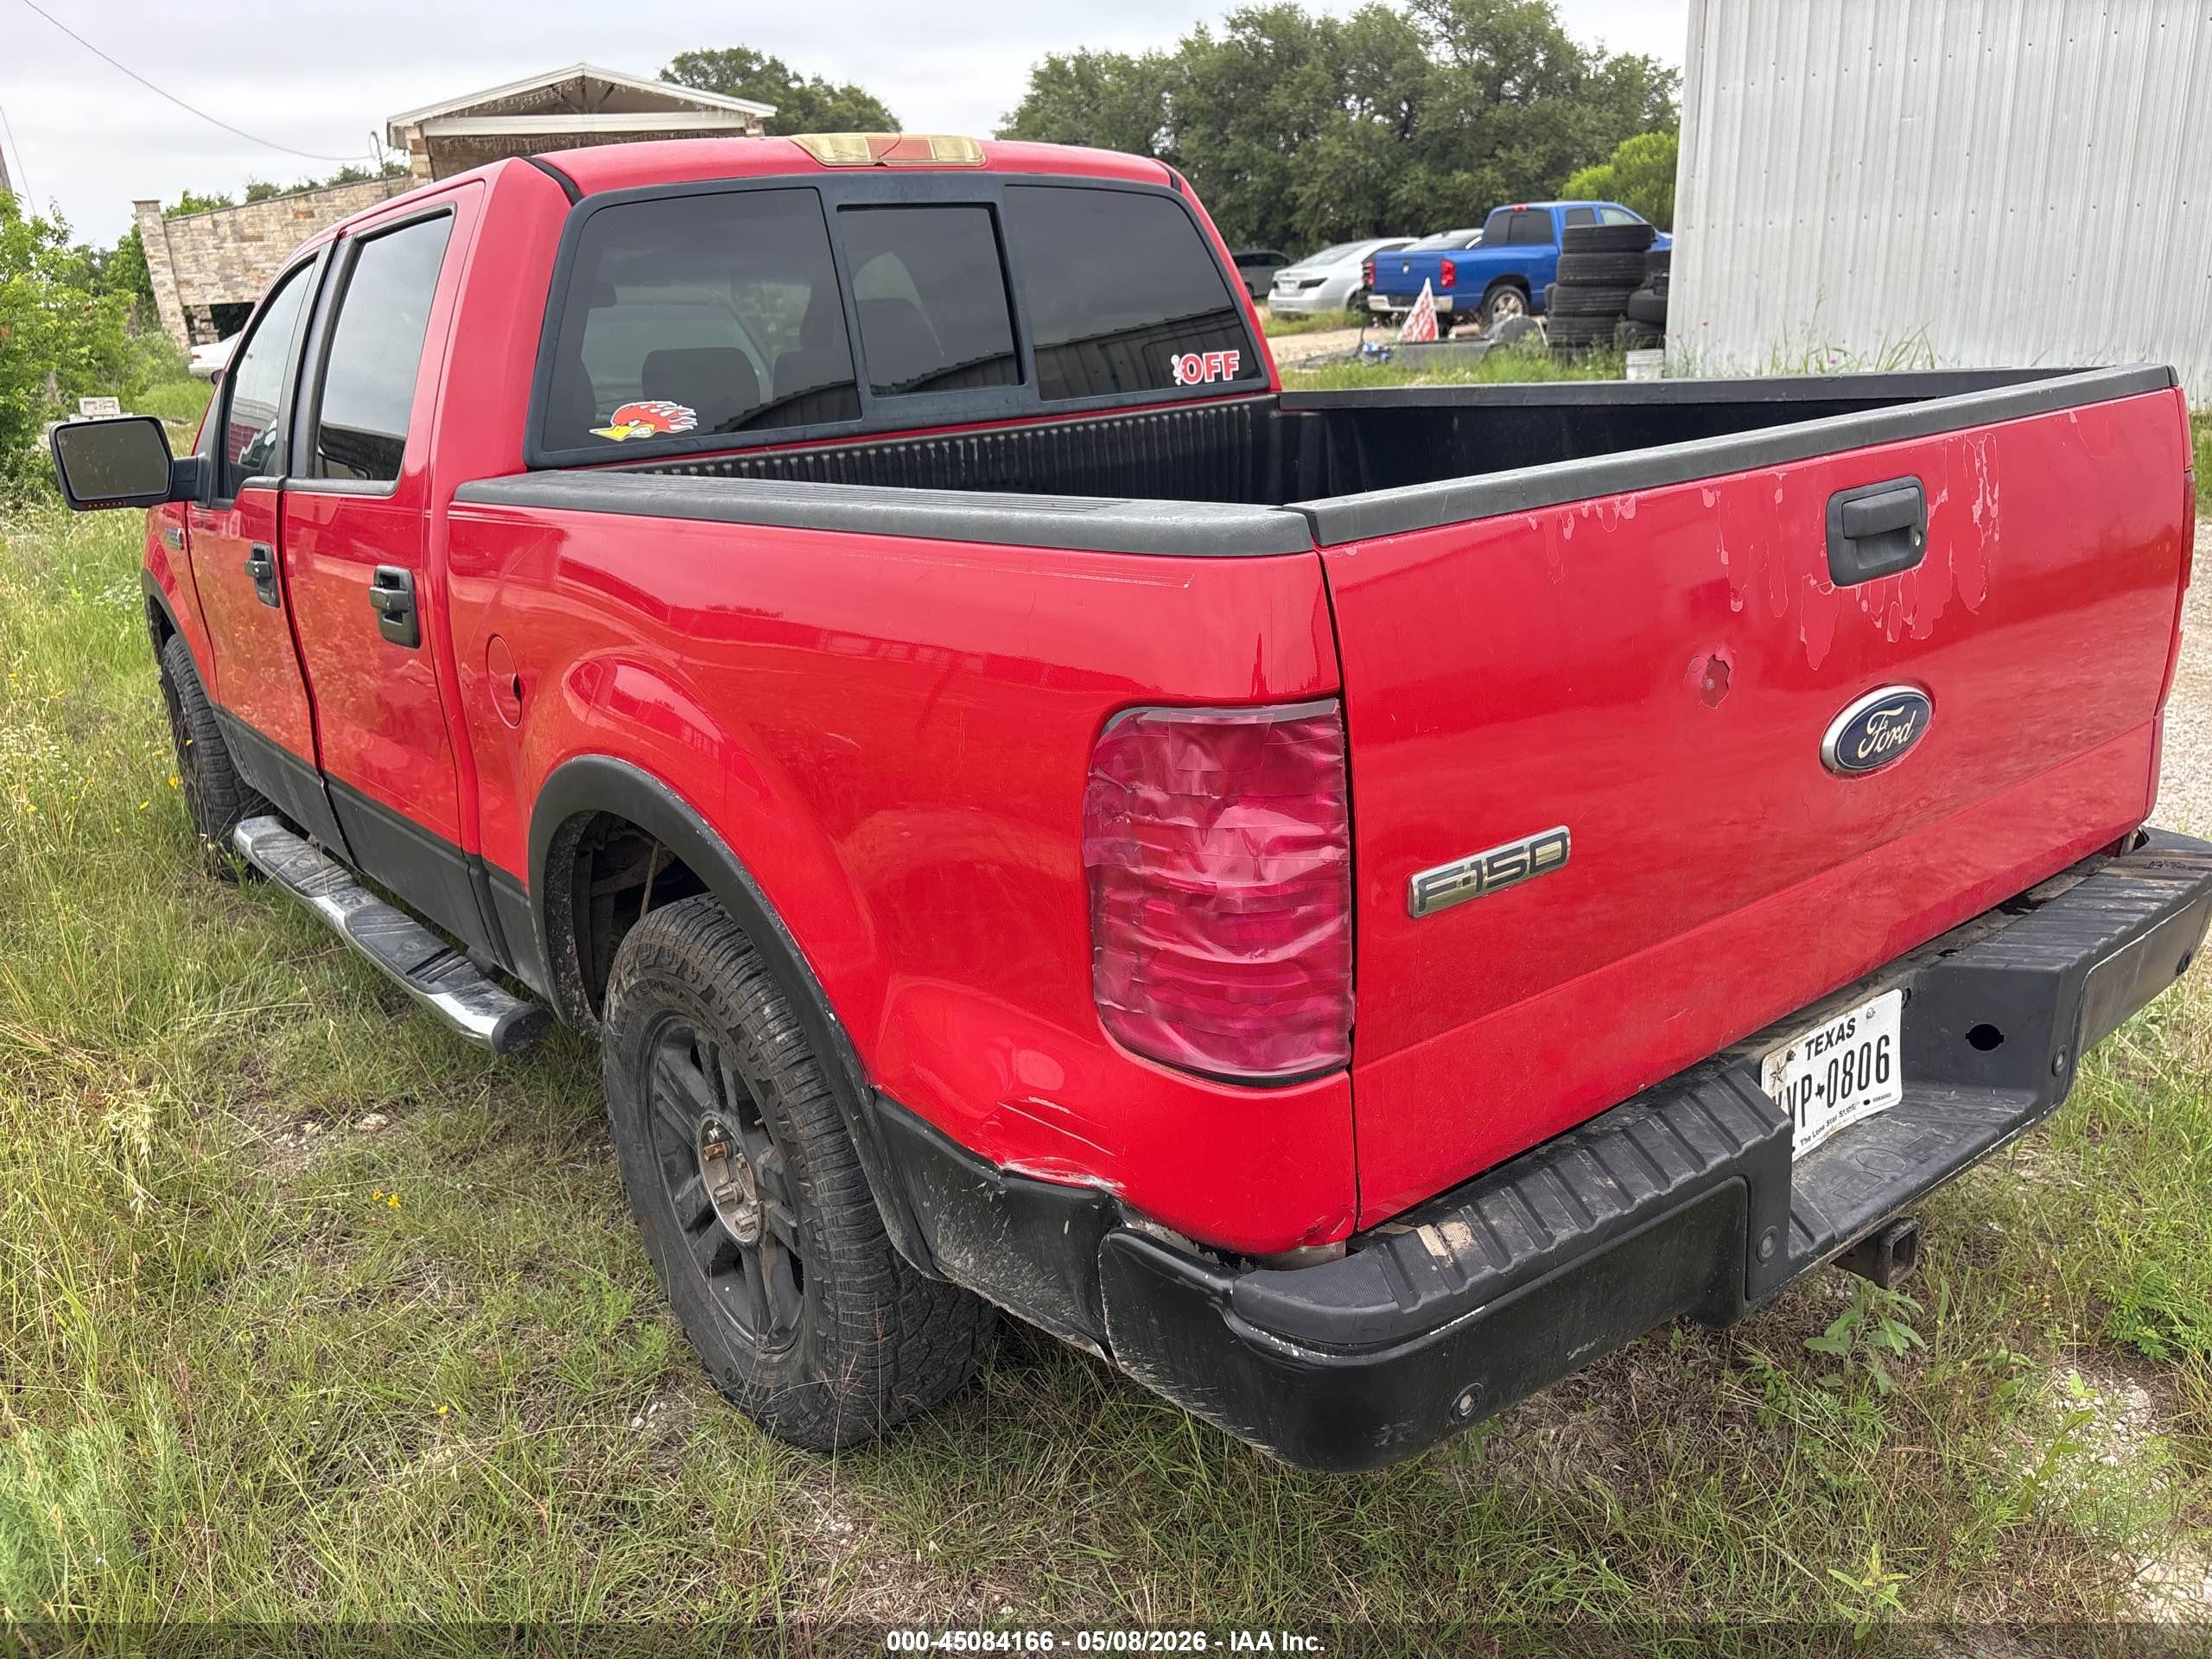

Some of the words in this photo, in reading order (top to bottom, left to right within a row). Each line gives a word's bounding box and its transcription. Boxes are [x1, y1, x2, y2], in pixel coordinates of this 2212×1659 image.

[1180, 350, 1240, 385] OFF
[1857, 704, 1917, 759] Ford
[1417, 830, 1569, 912] F-150
[1805, 1017, 1856, 1061] TEXAS
[1827, 1034, 1890, 1109] 0806
[1800, 1135, 1811, 1147] The
[1812, 1124, 1825, 1138] Lone
[1826, 1115, 1838, 1127] Star
[1839, 1103, 1857, 1118] State
